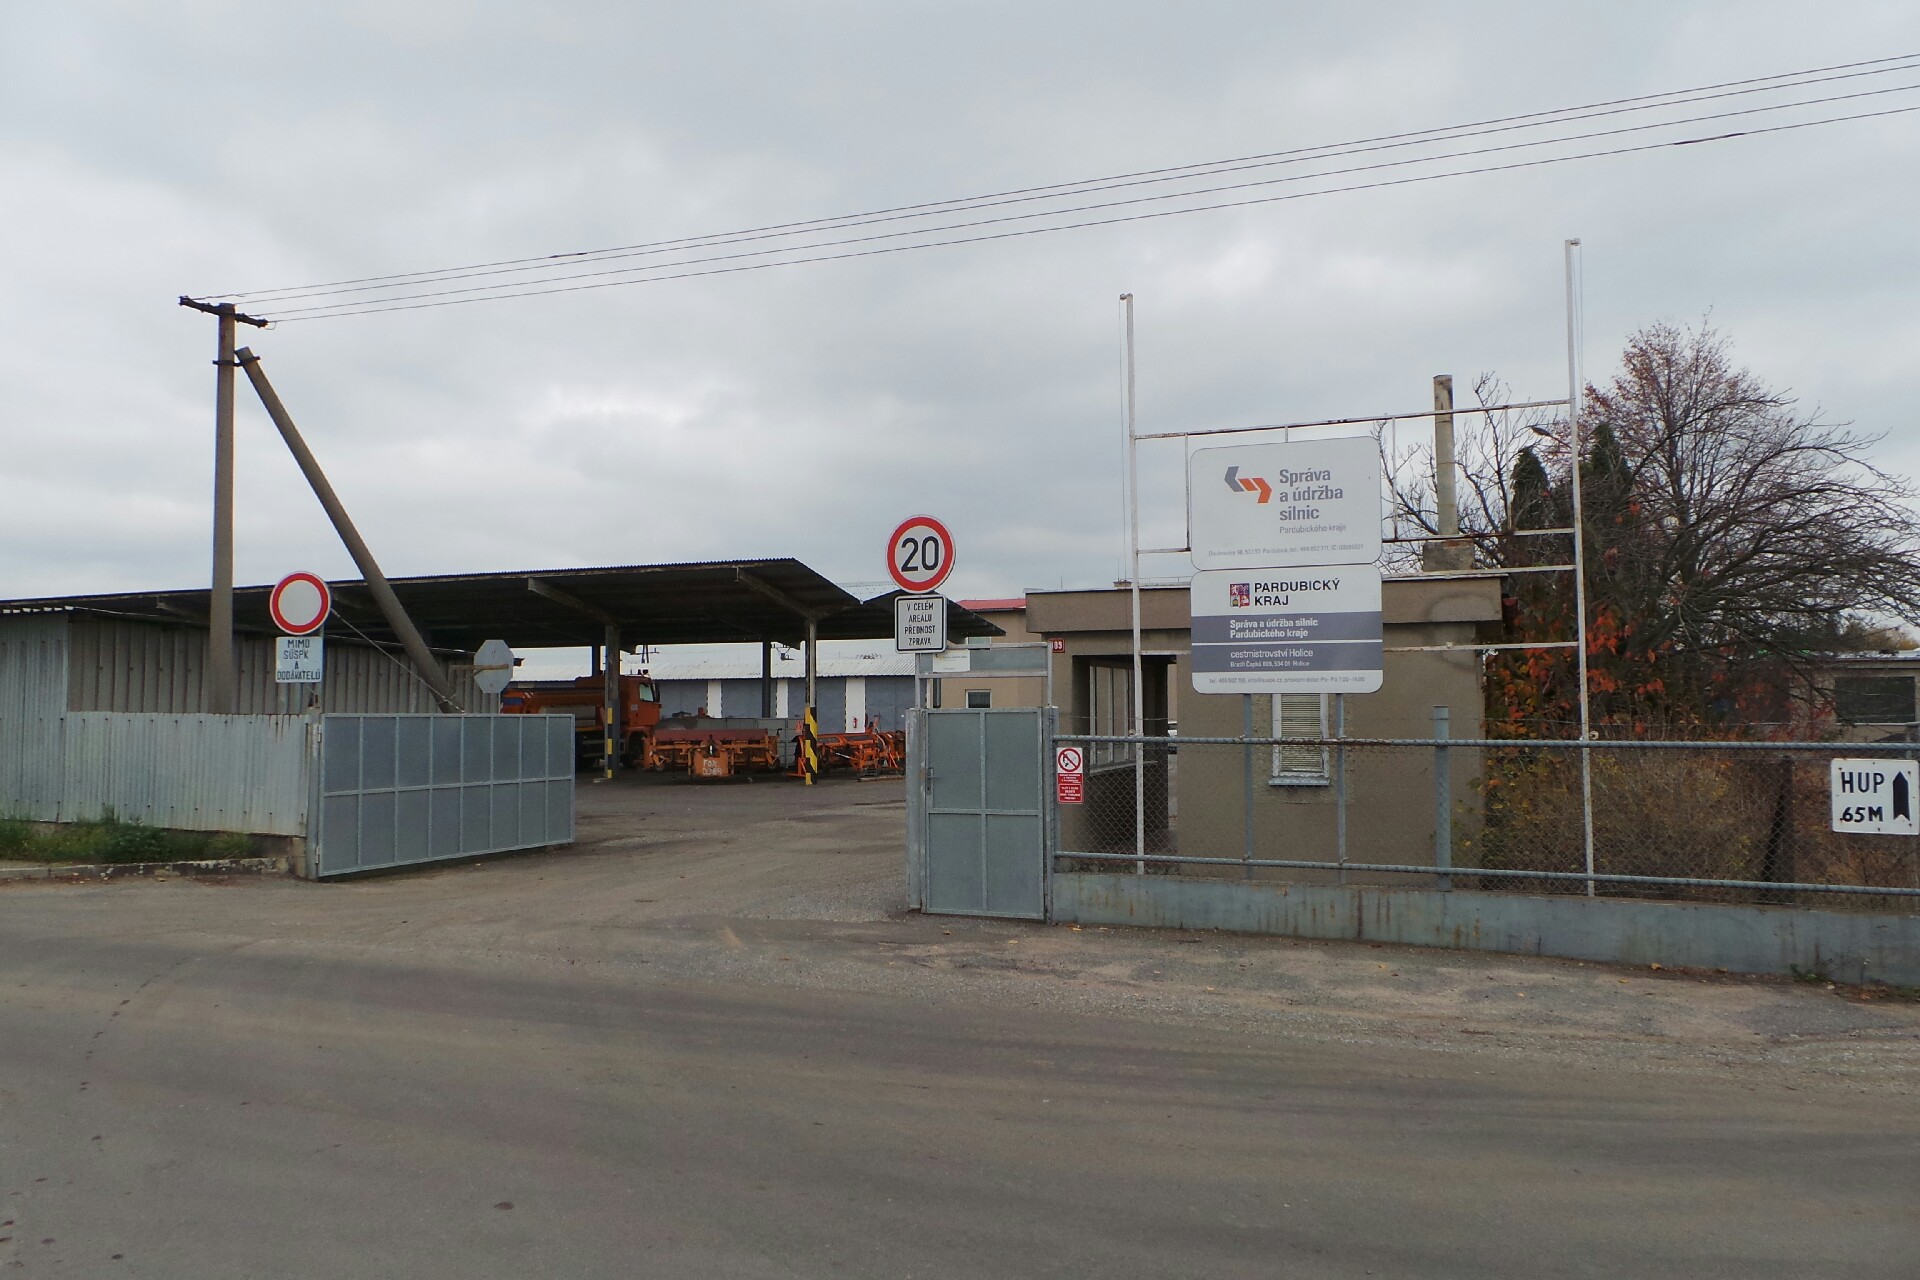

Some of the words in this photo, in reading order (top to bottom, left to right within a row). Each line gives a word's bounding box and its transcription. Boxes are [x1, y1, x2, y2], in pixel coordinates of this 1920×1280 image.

[1279, 467, 1331, 487] Správa
[1279, 491, 1289, 502] a
[1292, 485, 1343, 501] údržba
[1279, 504, 1320, 521] silnic
[901, 535, 940, 572] 20
[1254, 578, 1340, 593] PARDUBICKÝ
[906, 603, 911, 611] V
[913, 601, 934, 611] CELÉM
[1254, 595, 1289, 606] KRAJ
[904, 624, 936, 635] PŘEDNOST
[1229, 620, 1258, 630] Správa
[1266, 619, 1294, 628] údržba
[1295, 618, 1319, 627] silnic
[1229, 629, 1286, 639] Pardubického
[1287, 628, 1309, 639] kraje
[287, 639, 311, 648] MIMO
[1230, 649, 1288, 659] cestmistrovství
[1289, 648, 1314, 657] Holice
[294, 660, 299, 670] A
[1841, 771, 1885, 794] HUP
[1842, 805, 1884, 823] 65M
